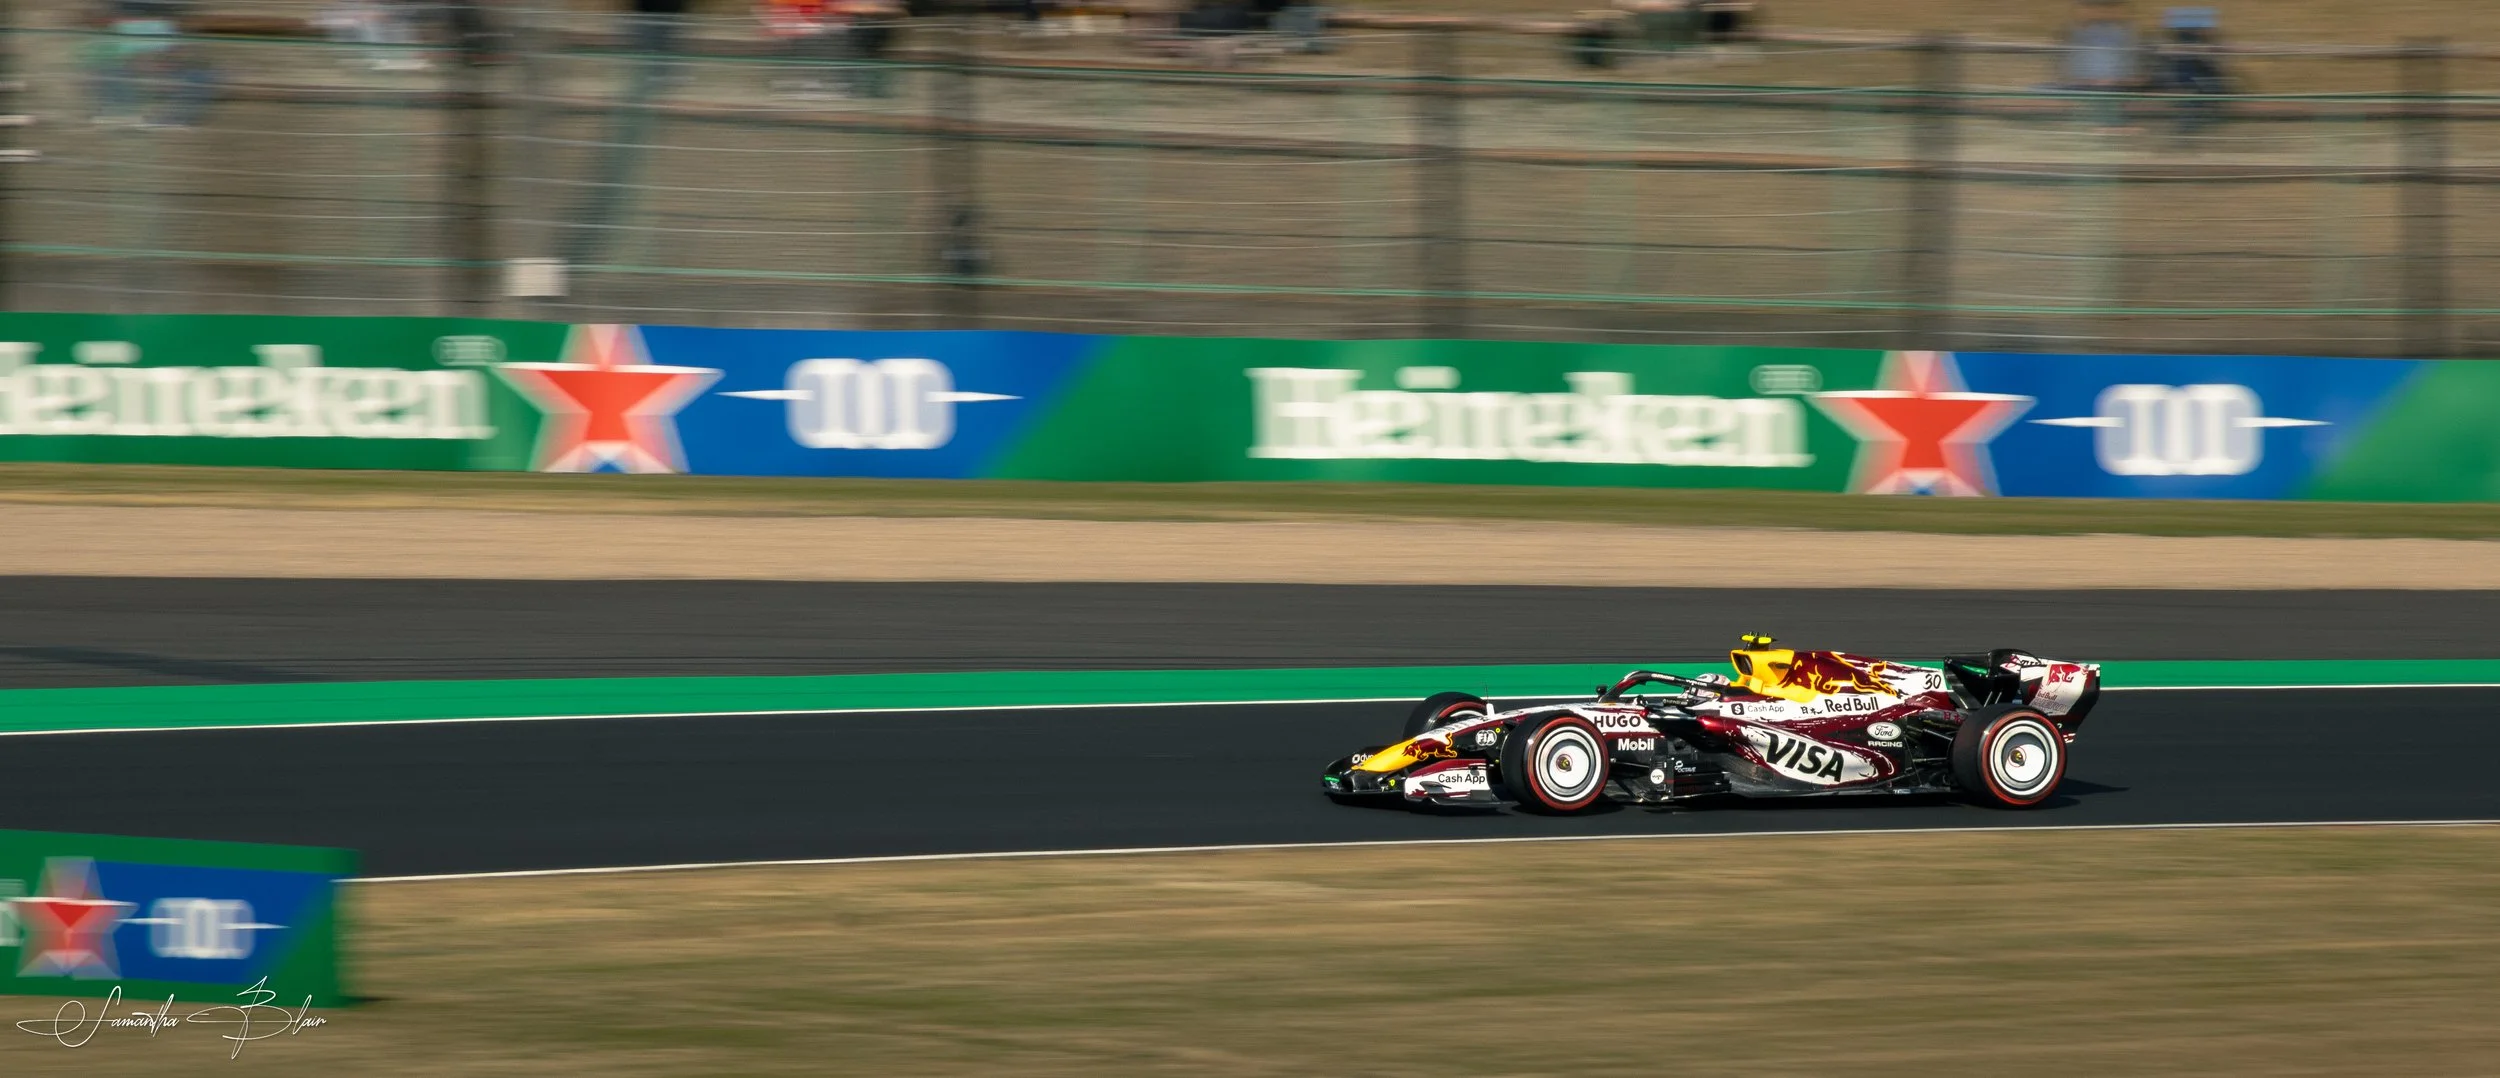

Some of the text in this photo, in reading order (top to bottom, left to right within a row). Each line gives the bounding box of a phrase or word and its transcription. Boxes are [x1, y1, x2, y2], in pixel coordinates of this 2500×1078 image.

[1243, 365, 1816, 467] Heineken
[1923, 673, 1942, 690] 30
[1747, 704, 1785, 713] Cash App
[1824, 697, 1879, 713] Red Bull
[1594, 715, 1641, 728] HUGO
[1874, 725, 1894, 737] Ford
[1477, 732, 1496, 744] FIA
[1617, 738, 1655, 751] Mobil
[1867, 740, 1903, 748] RACING
[1762, 730, 1845, 783] VISA
[1437, 774, 1486, 784] Cash App
